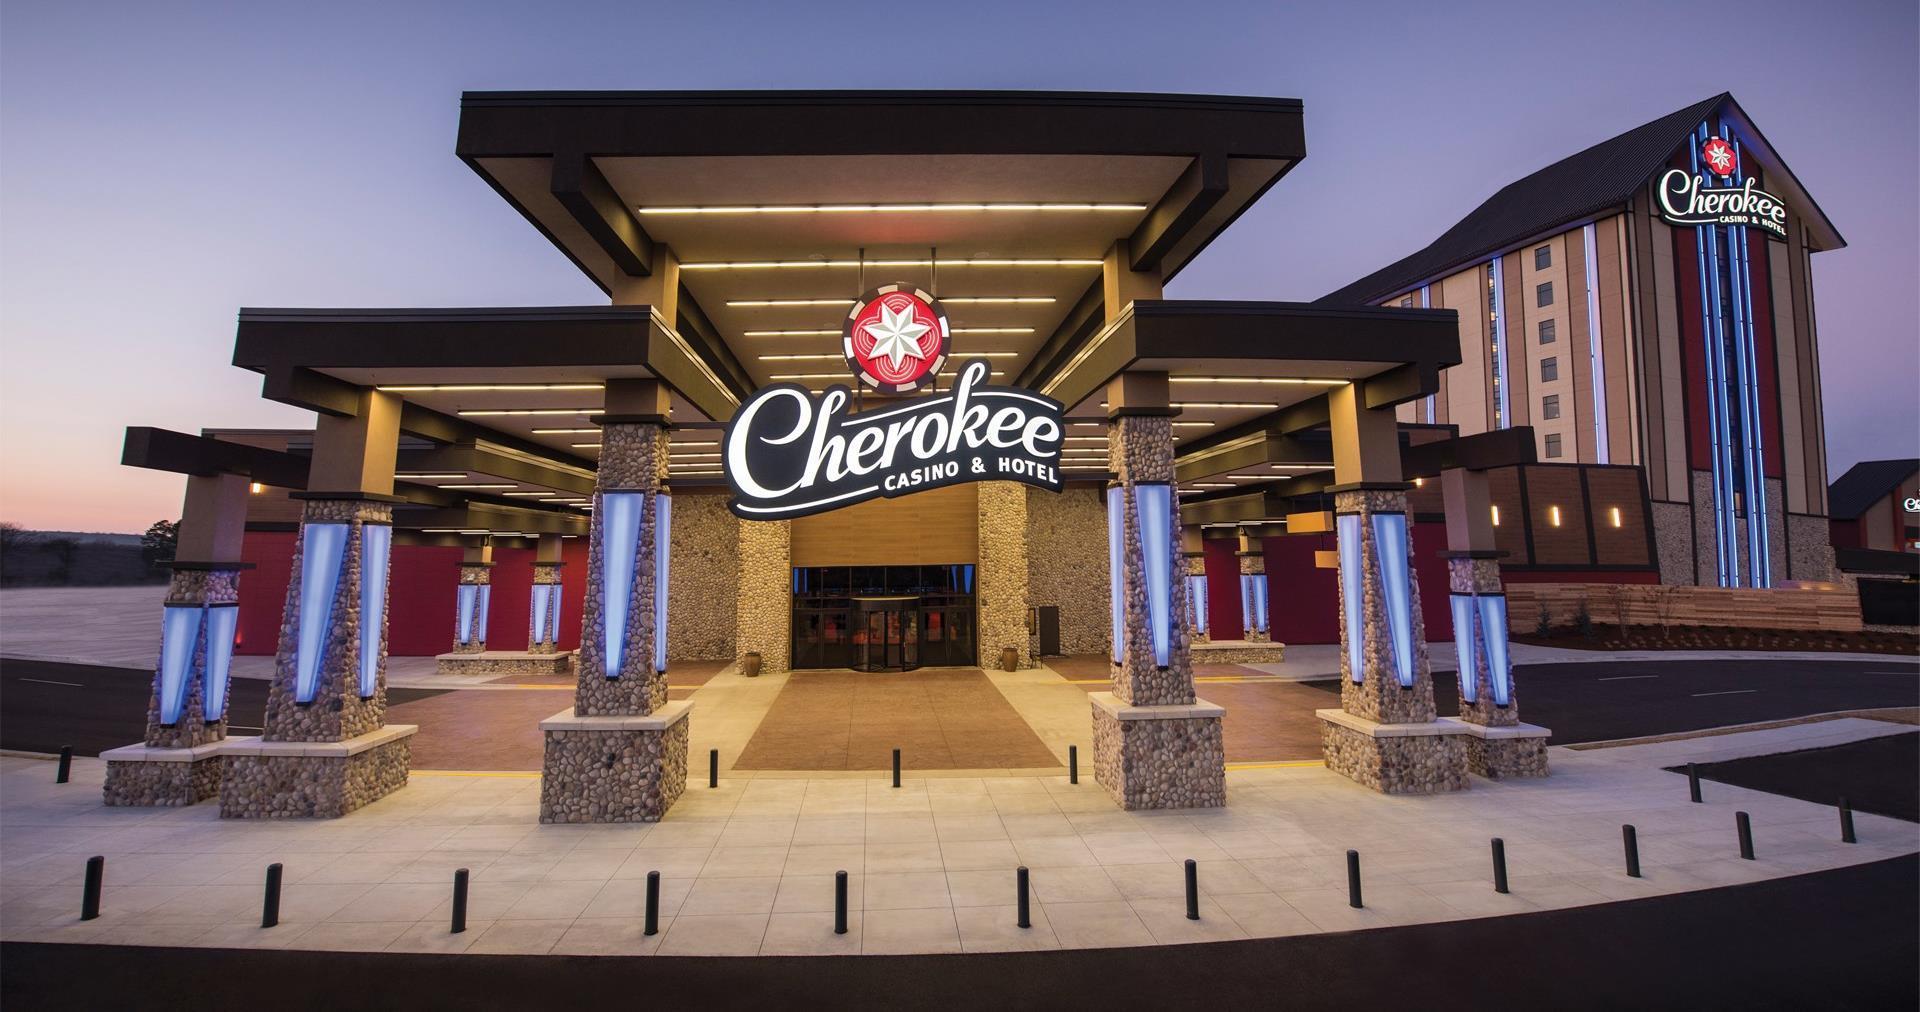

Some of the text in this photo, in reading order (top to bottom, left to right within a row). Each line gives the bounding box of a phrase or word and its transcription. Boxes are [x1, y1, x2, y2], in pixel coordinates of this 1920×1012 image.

[1660, 169, 1786, 224] Cherokee
[1719, 215, 1787, 236] CASINO & HOTEL
[728, 362, 1061, 498] Cherokee
[884, 457, 1059, 491] CASINO & HOTEL
